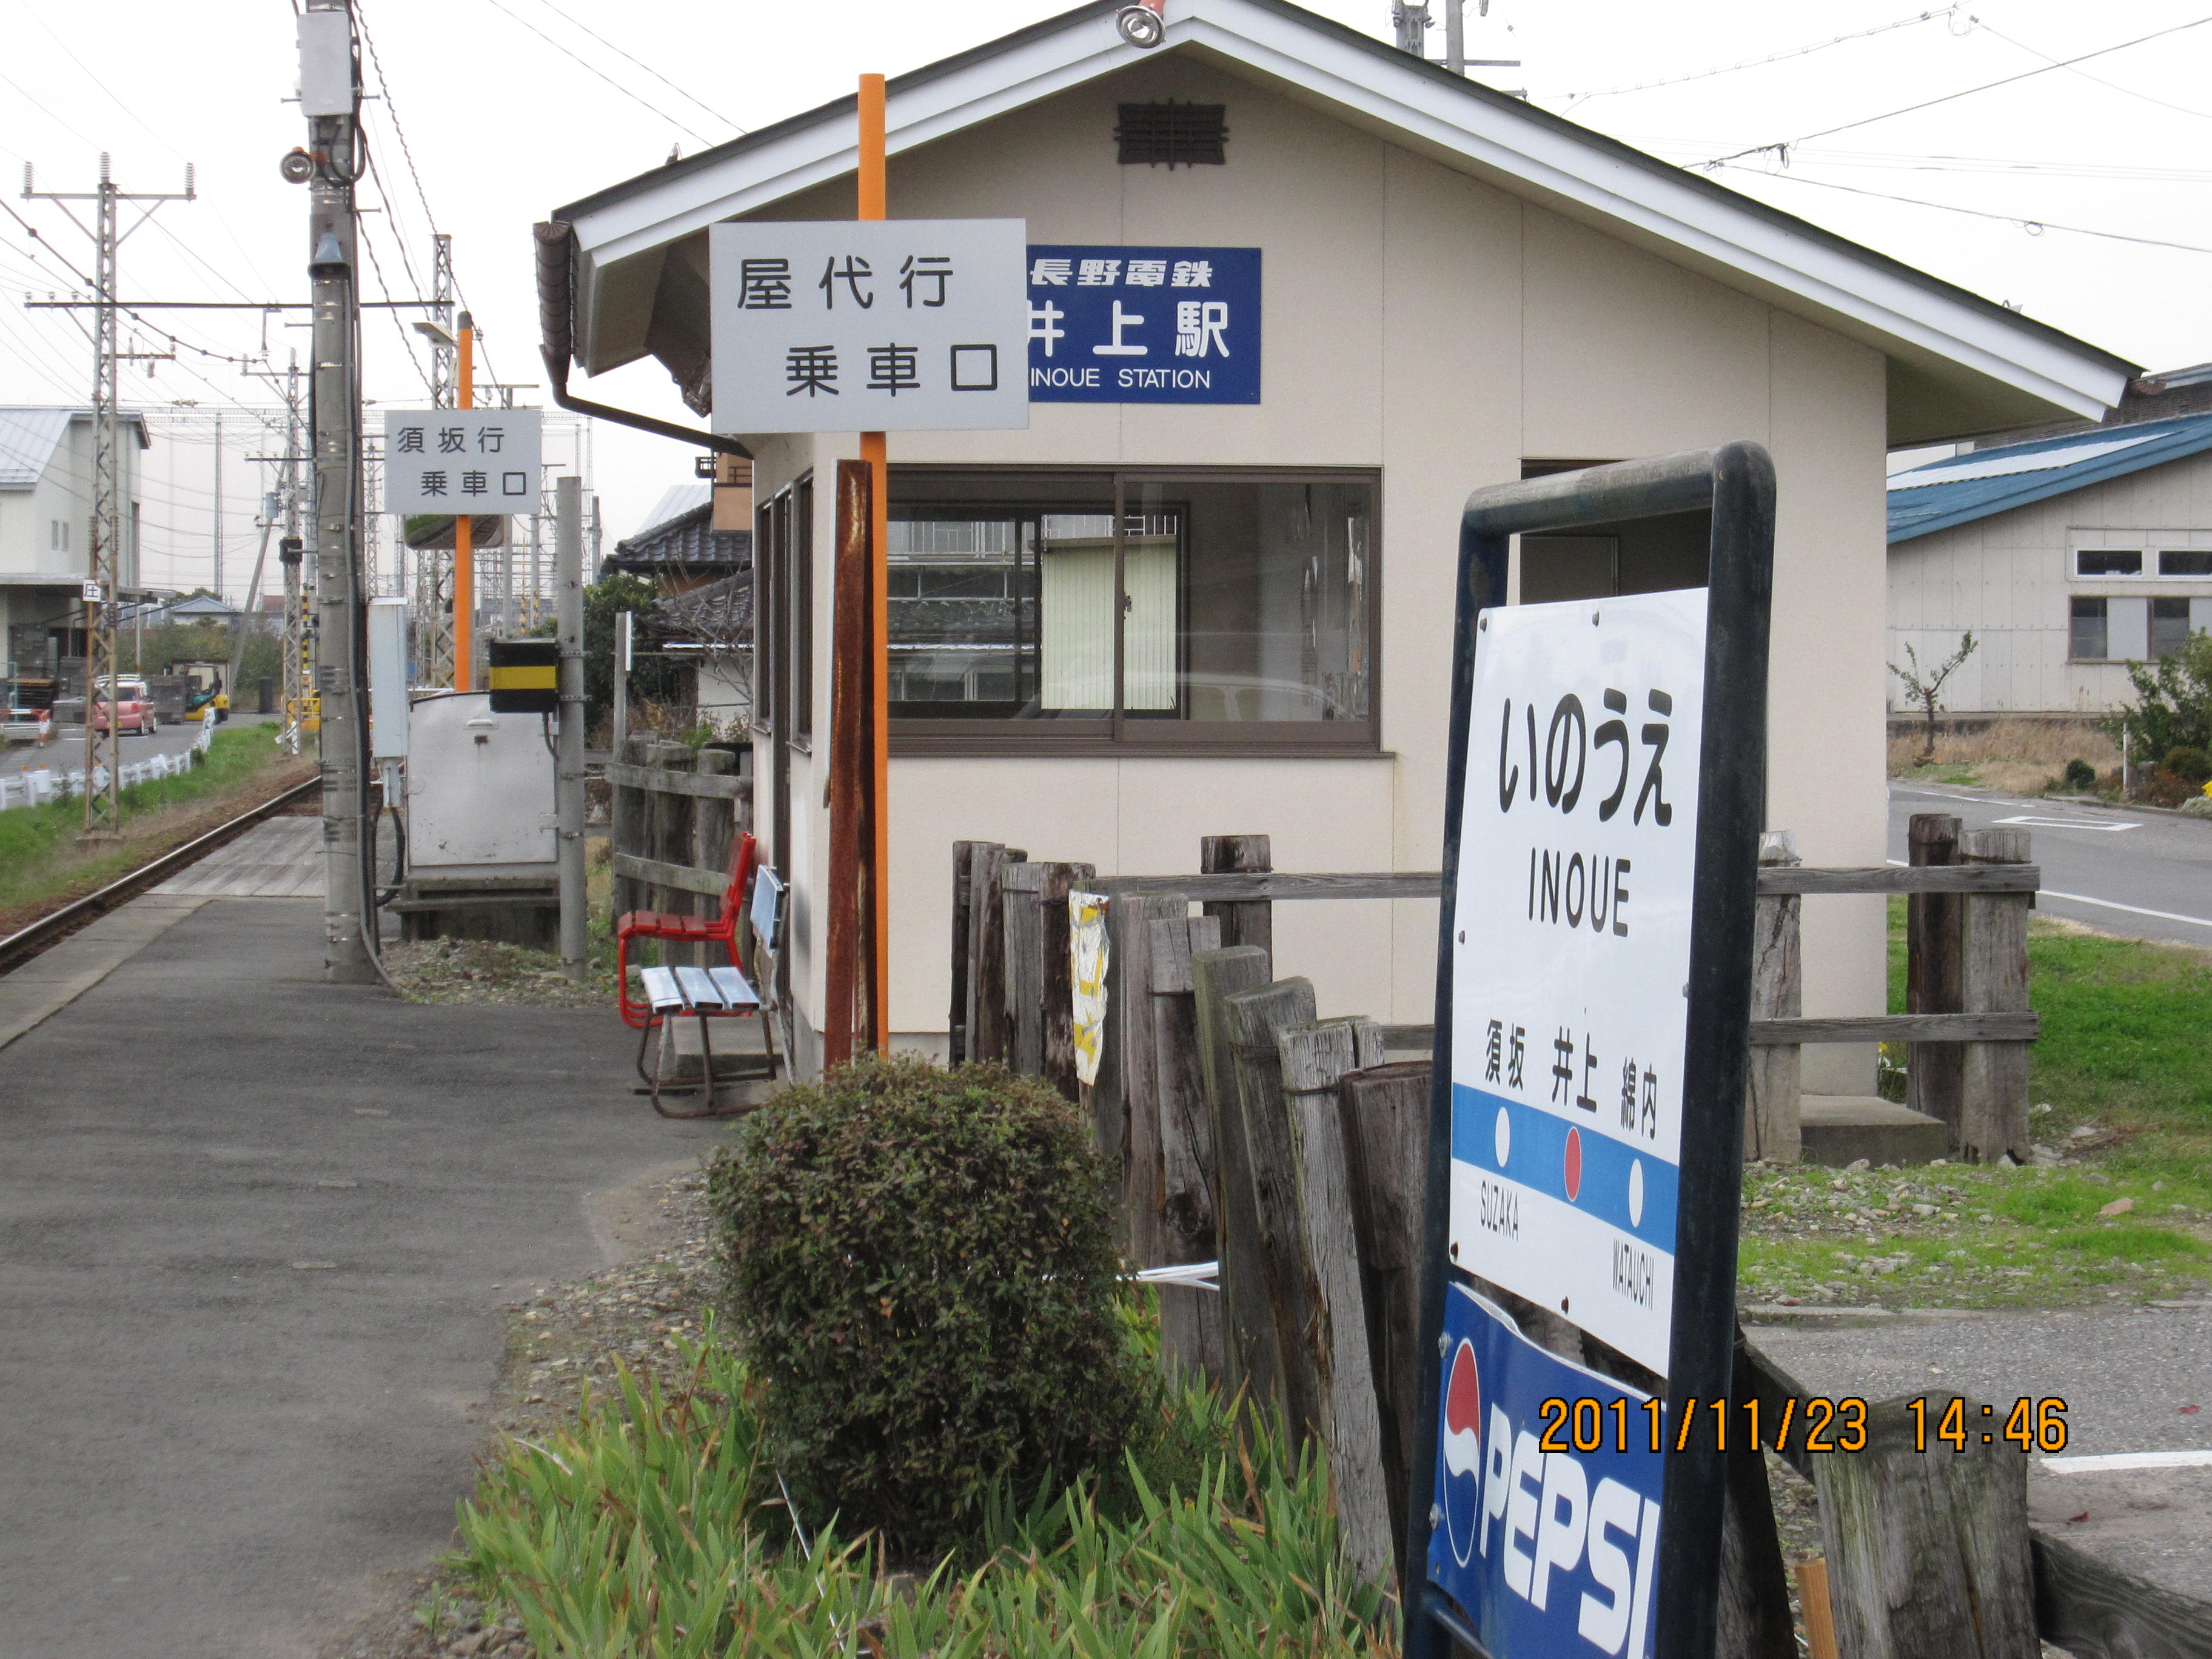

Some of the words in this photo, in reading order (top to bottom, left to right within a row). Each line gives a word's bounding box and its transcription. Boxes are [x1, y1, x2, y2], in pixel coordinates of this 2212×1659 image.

[737, 254, 954, 309] 屋代行
[1030, 259, 1213, 287] 長野電鉄
[1027, 300, 1230, 358] 井上駅
[786, 343, 998, 397] 乗車口
[1031, 368, 1100, 387] INOUE
[1118, 369, 1210, 388] STATION
[397, 426, 505, 454] 須坂行
[421, 471, 527, 497] 乗車口
[1499, 688, 1672, 827] いのうえ
[1529, 846, 1631, 937] INOUE
[1485, 1019, 1526, 1091] 須坂
[1552, 1025, 1598, 1113] 井上
[1620, 1057, 1658, 1140] 綿内
[1480, 1180, 1520, 1242] SUZAKA
[1613, 1239, 1654, 1311] WATAUCHI
[1480, 1403, 1660, 1659] PEPSI
